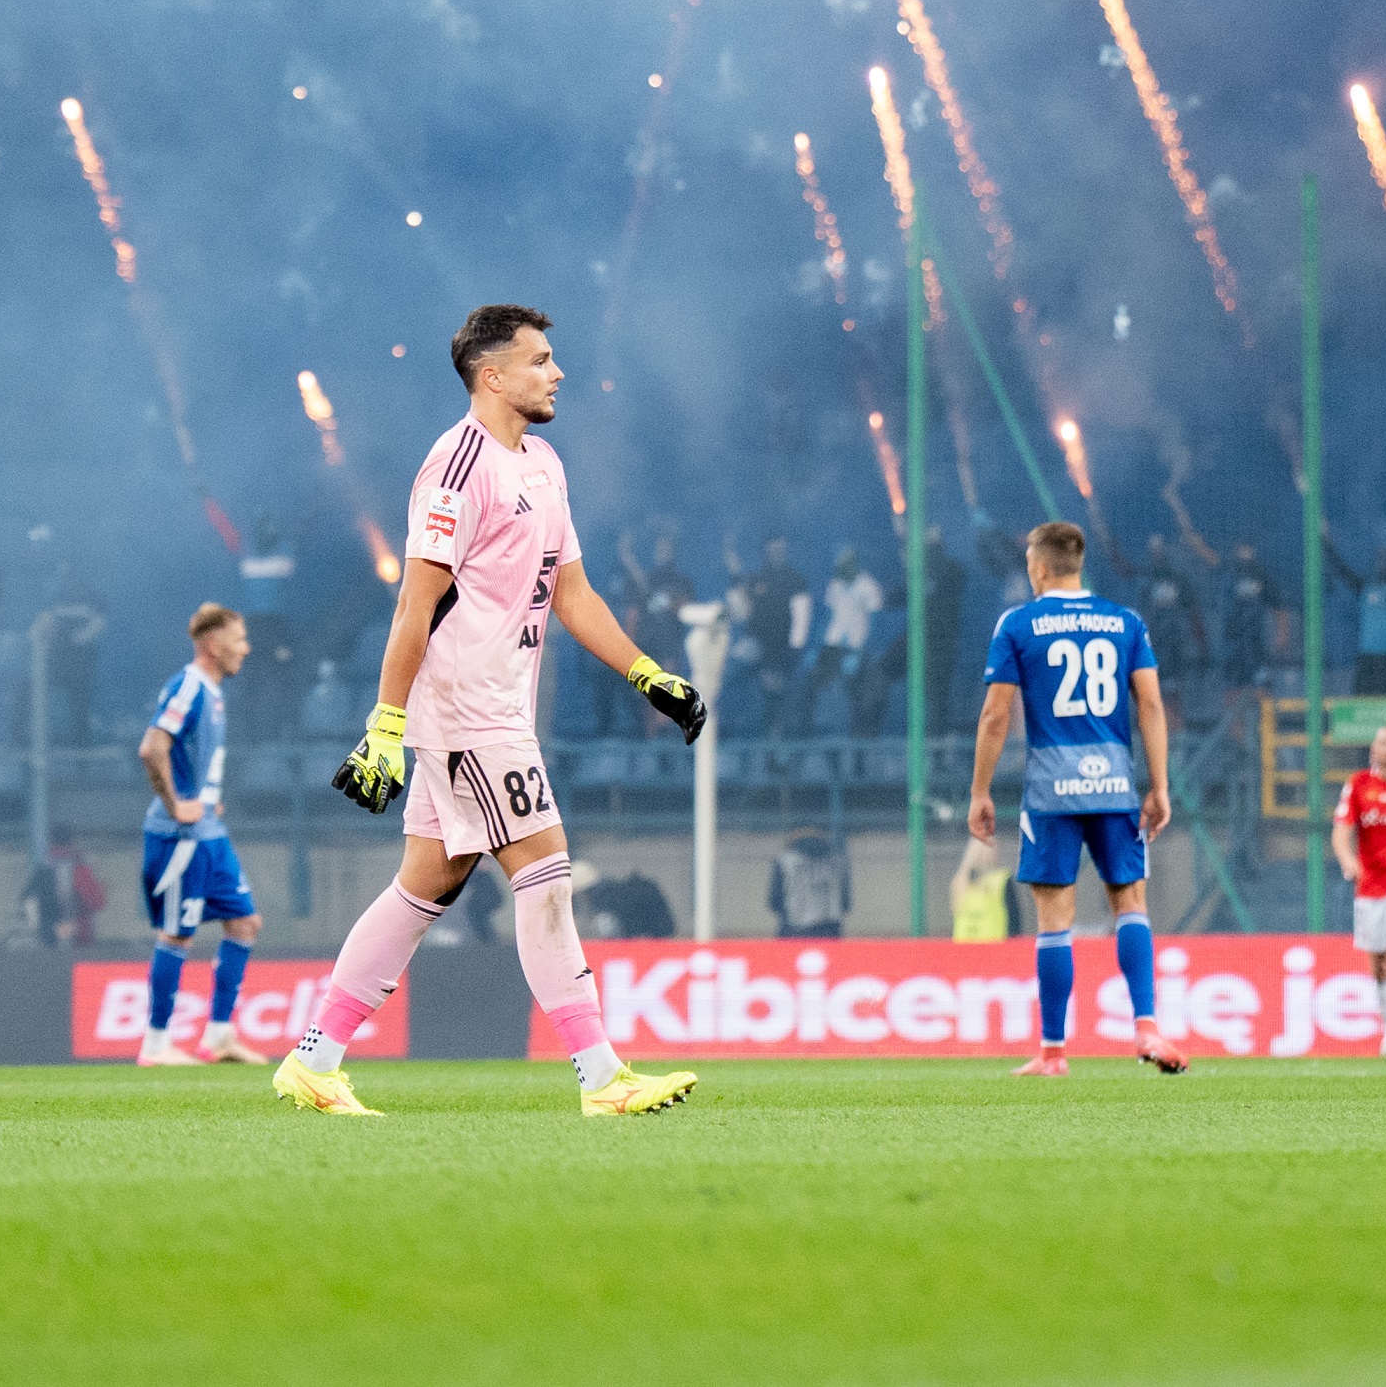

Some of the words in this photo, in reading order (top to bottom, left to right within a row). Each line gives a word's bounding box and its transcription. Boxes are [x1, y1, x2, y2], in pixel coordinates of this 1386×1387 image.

[433, 505, 456, 515] SUZUKI
[1032, 612, 1125, 636] LEŚNIAK-PADUCH
[1047, 637, 1119, 717] 28
[503, 766, 551, 818] 82
[1054, 777, 1130, 795] UROVITA
[603, 949, 1076, 1043] Kibicem
